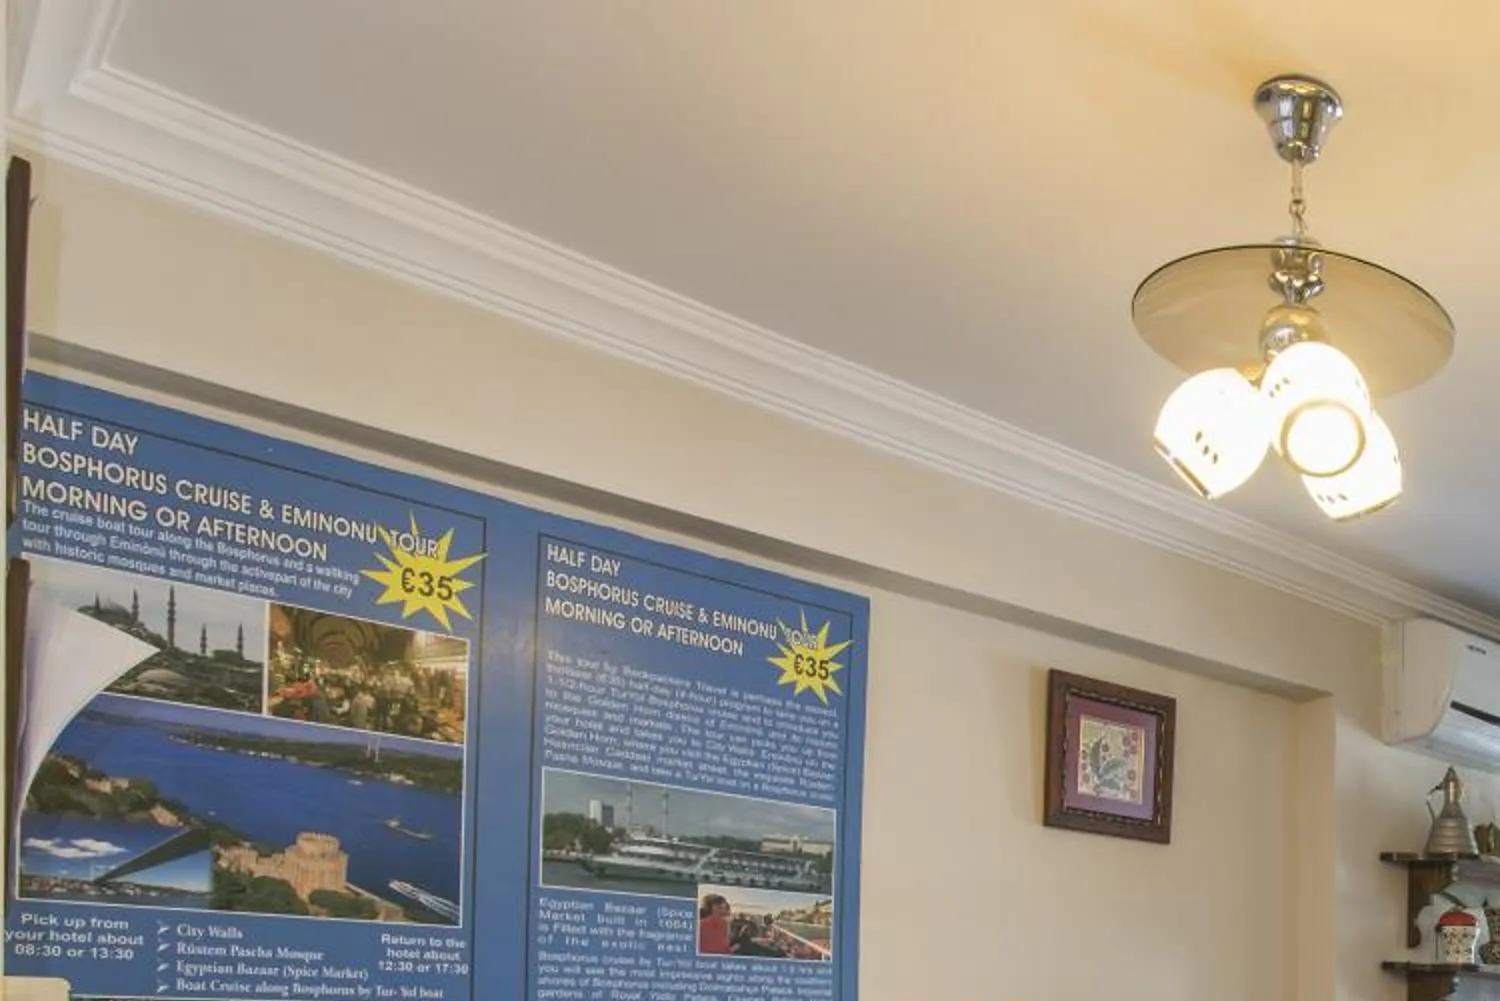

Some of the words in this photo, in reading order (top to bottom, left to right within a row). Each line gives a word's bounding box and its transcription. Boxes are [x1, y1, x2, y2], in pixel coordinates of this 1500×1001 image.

[23, 408, 84, 441] HALF
[91, 425, 139, 456] DAY
[22, 475, 149, 521] MORNING
[156, 506, 191, 532] OR
[197, 515, 328, 562] AFTERNOON
[23, 442, 167, 495] BOSPHORUS
[175, 479, 252, 515] CRUISE
[259, 499, 275, 521] &
[281, 504, 377, 544] EMINONU
[390, 529, 438, 558] TOUR
[22, 537, 51, 553] with
[23, 519, 51, 534] tour
[54, 525, 107, 547] through
[169, 549, 217, 571] through
[24, 500, 48, 517] The
[129, 523, 154, 538] tour
[157, 530, 192, 550] along
[547, 543, 585, 569] HALF
[591, 554, 621, 577] DAY
[401, 567, 453, 601] €35
[547, 570, 640, 607] BOSPHORUS
[643, 594, 695, 621] CRUISE
[712, 611, 777, 640] EMINONU
[545, 597, 626, 630] MORNING
[631, 616, 652, 638] OR
[657, 619, 743, 657] AFTERNOON
[793, 653, 830, 681] €35
[20, 912, 59, 927] Pick
[64, 917, 87, 930] up
[91, 916, 130, 931] from
[50, 930, 92, 944] hotel
[97, 932, 145, 946] about
[15, 943, 61, 957] 08:30
[67, 948, 85, 958] or
[92, 946, 135, 961] 13:30
